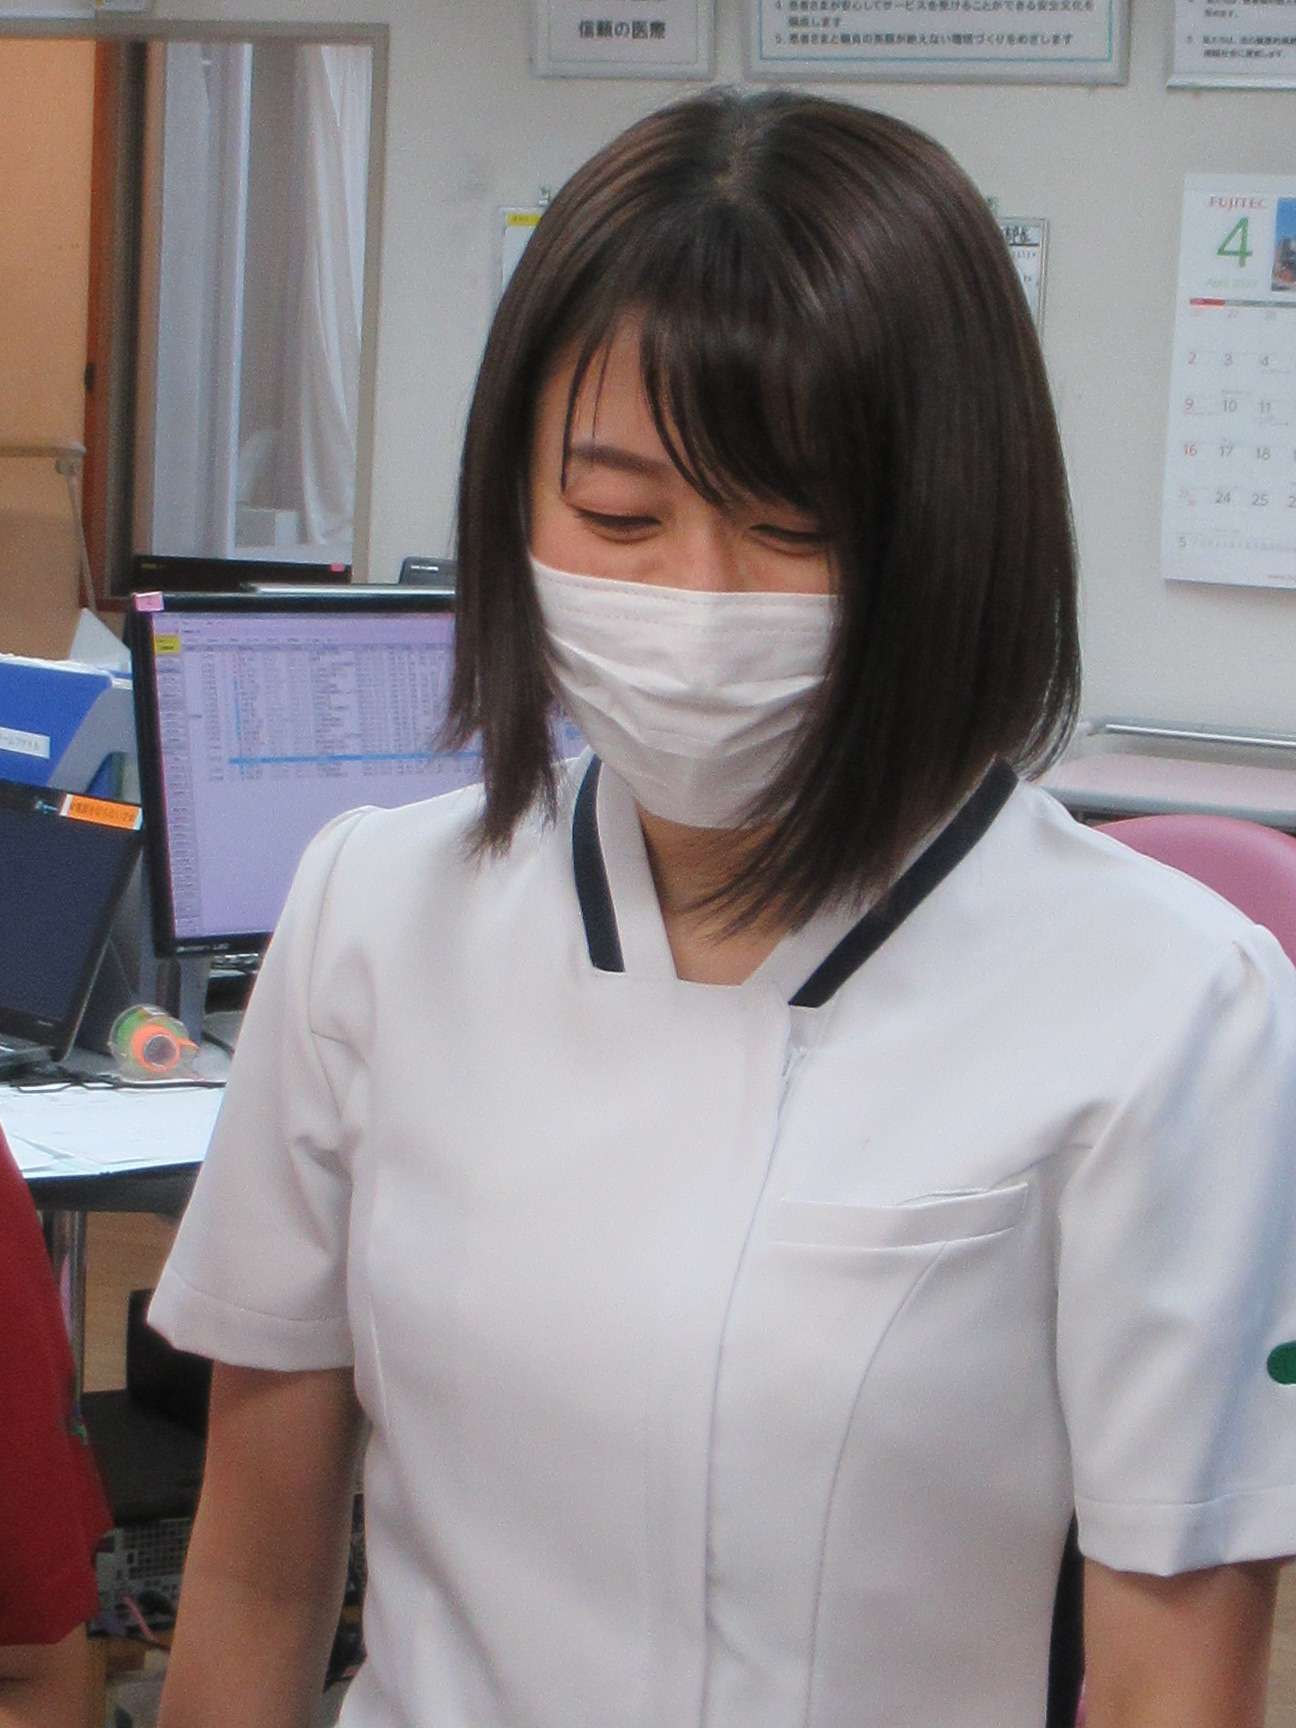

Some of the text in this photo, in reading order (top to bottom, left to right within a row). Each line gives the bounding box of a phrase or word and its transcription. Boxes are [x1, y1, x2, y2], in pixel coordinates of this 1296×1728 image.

[578, 21, 667, 40] 信頼の医療
[1208, 195, 1266, 210] FUJITEC
[1216, 216, 1253, 268] 4
[1184, 398, 1194, 411] 9
[1222, 399, 1238, 412] 10
[1259, 401, 1272, 414] 11
[1183, 443, 1198, 456] 16
[1218, 444, 1234, 457] 17
[1256, 447, 1271, 460] 18
[1215, 490, 1231, 504] 24
[1251, 493, 1269, 507] 25
